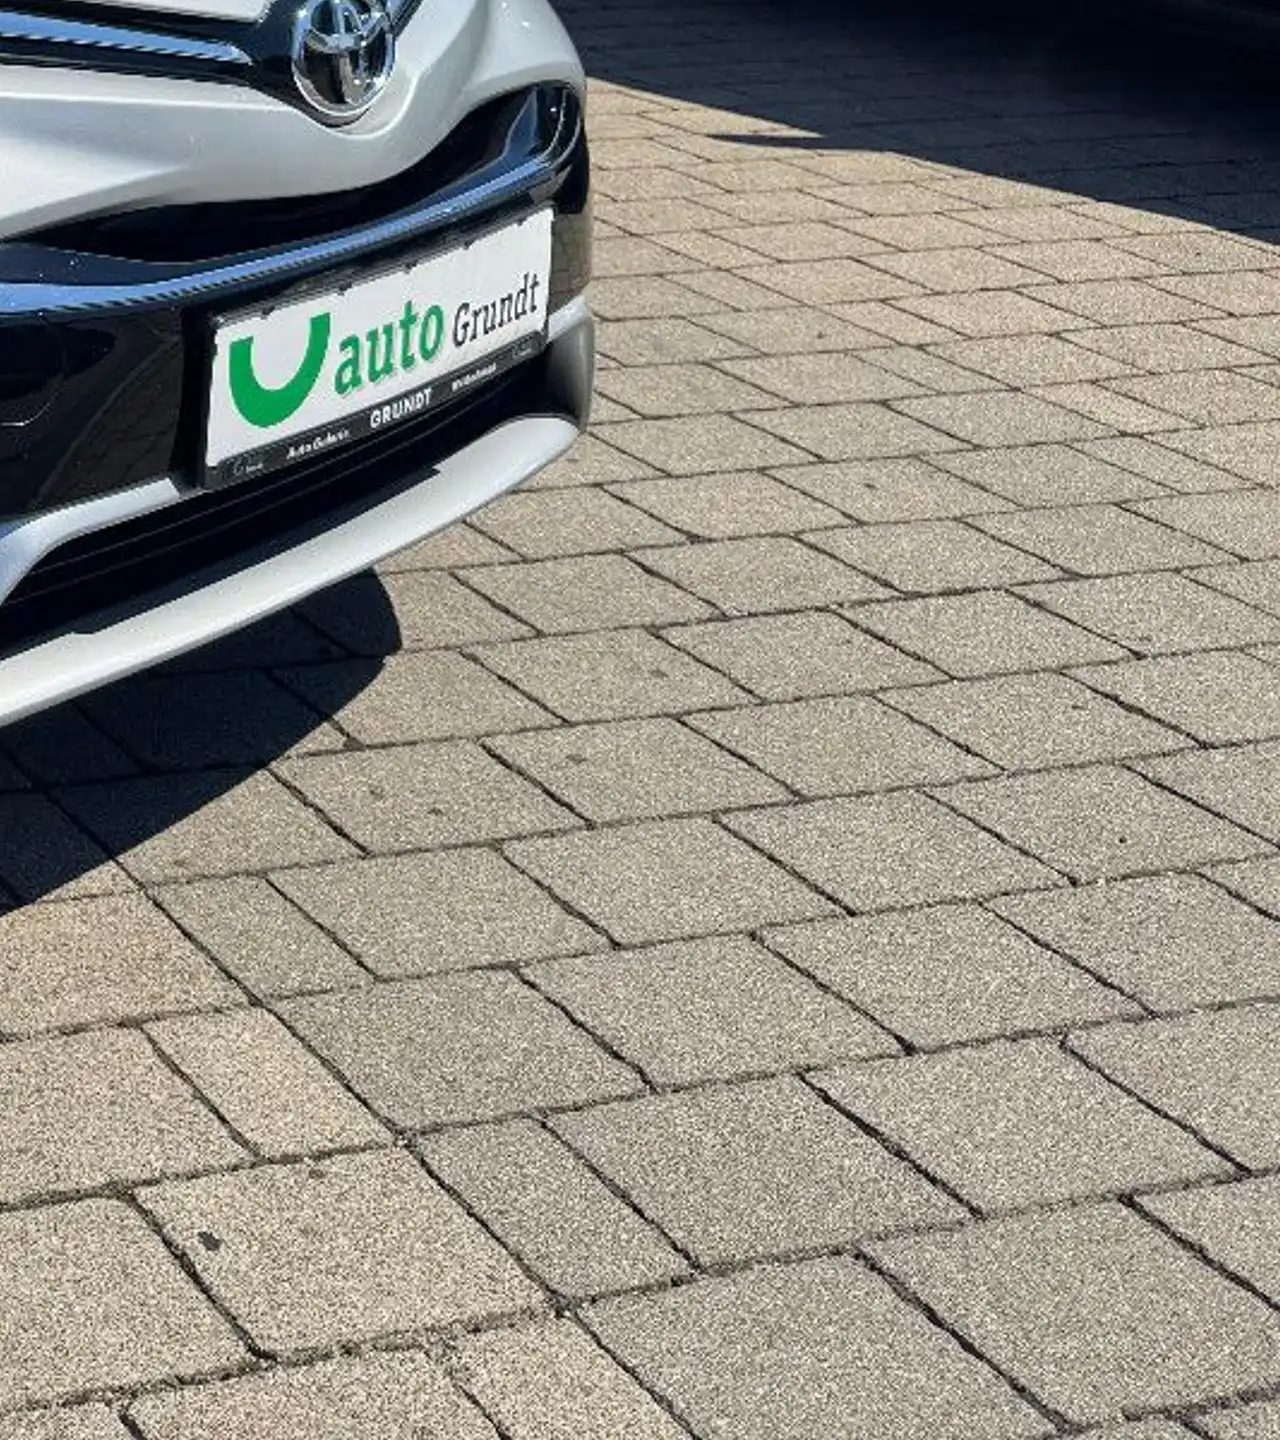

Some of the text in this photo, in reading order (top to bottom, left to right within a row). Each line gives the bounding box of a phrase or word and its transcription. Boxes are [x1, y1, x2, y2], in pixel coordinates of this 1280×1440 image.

[334, 271, 540, 397] auto Grundt
[369, 387, 433, 429] GRUNDT
